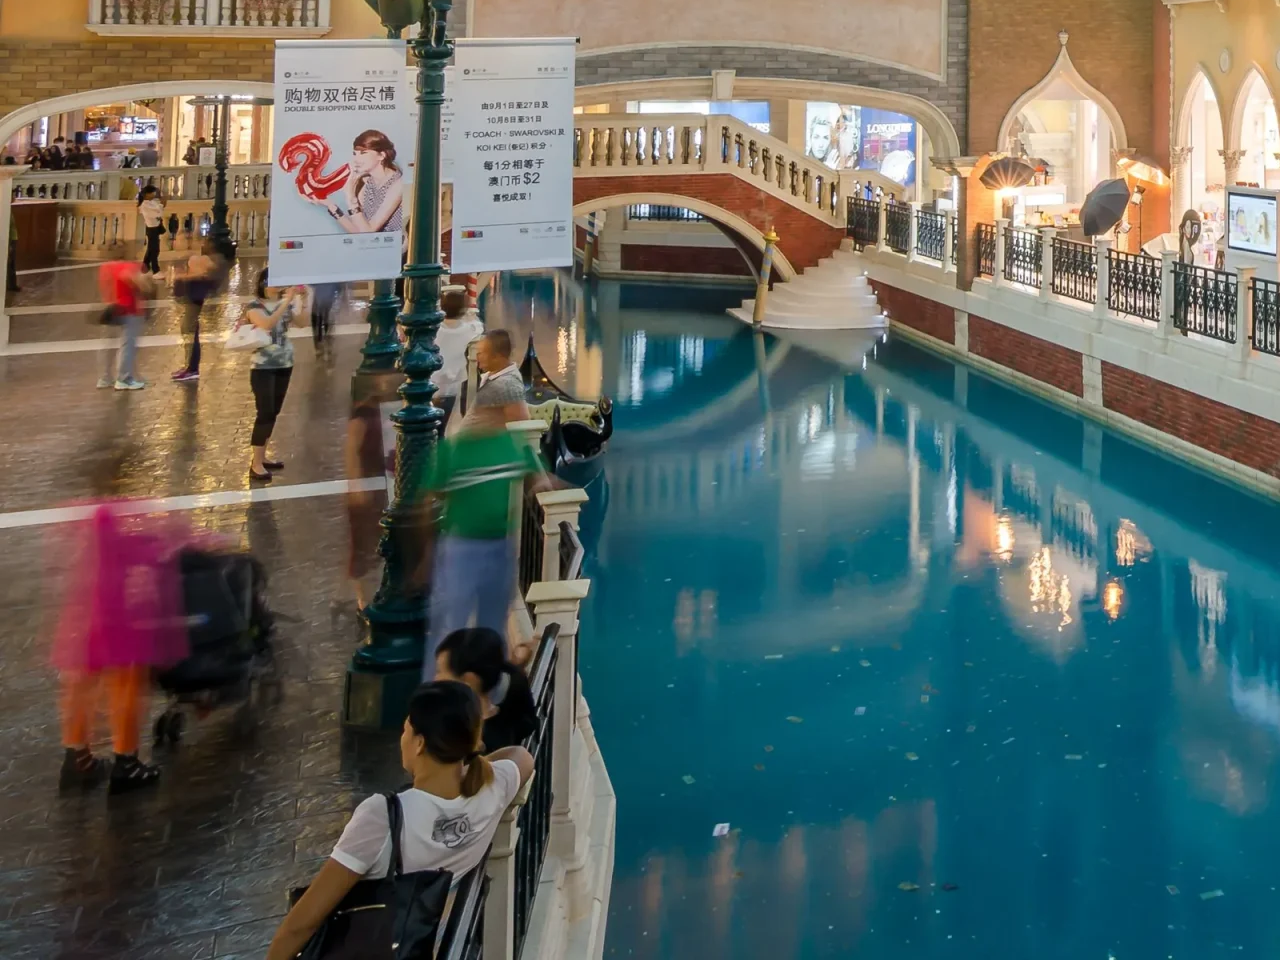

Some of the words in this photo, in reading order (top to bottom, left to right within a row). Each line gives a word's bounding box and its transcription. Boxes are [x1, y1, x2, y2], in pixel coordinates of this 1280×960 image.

[284, 86, 396, 104] 购物双倍尽情
[284, 105, 316, 113] DOUBLE
[317, 104, 356, 112] SHOPPING
[358, 103, 396, 111] REWARDS
[483, 158, 545, 171] 每1分相等于
